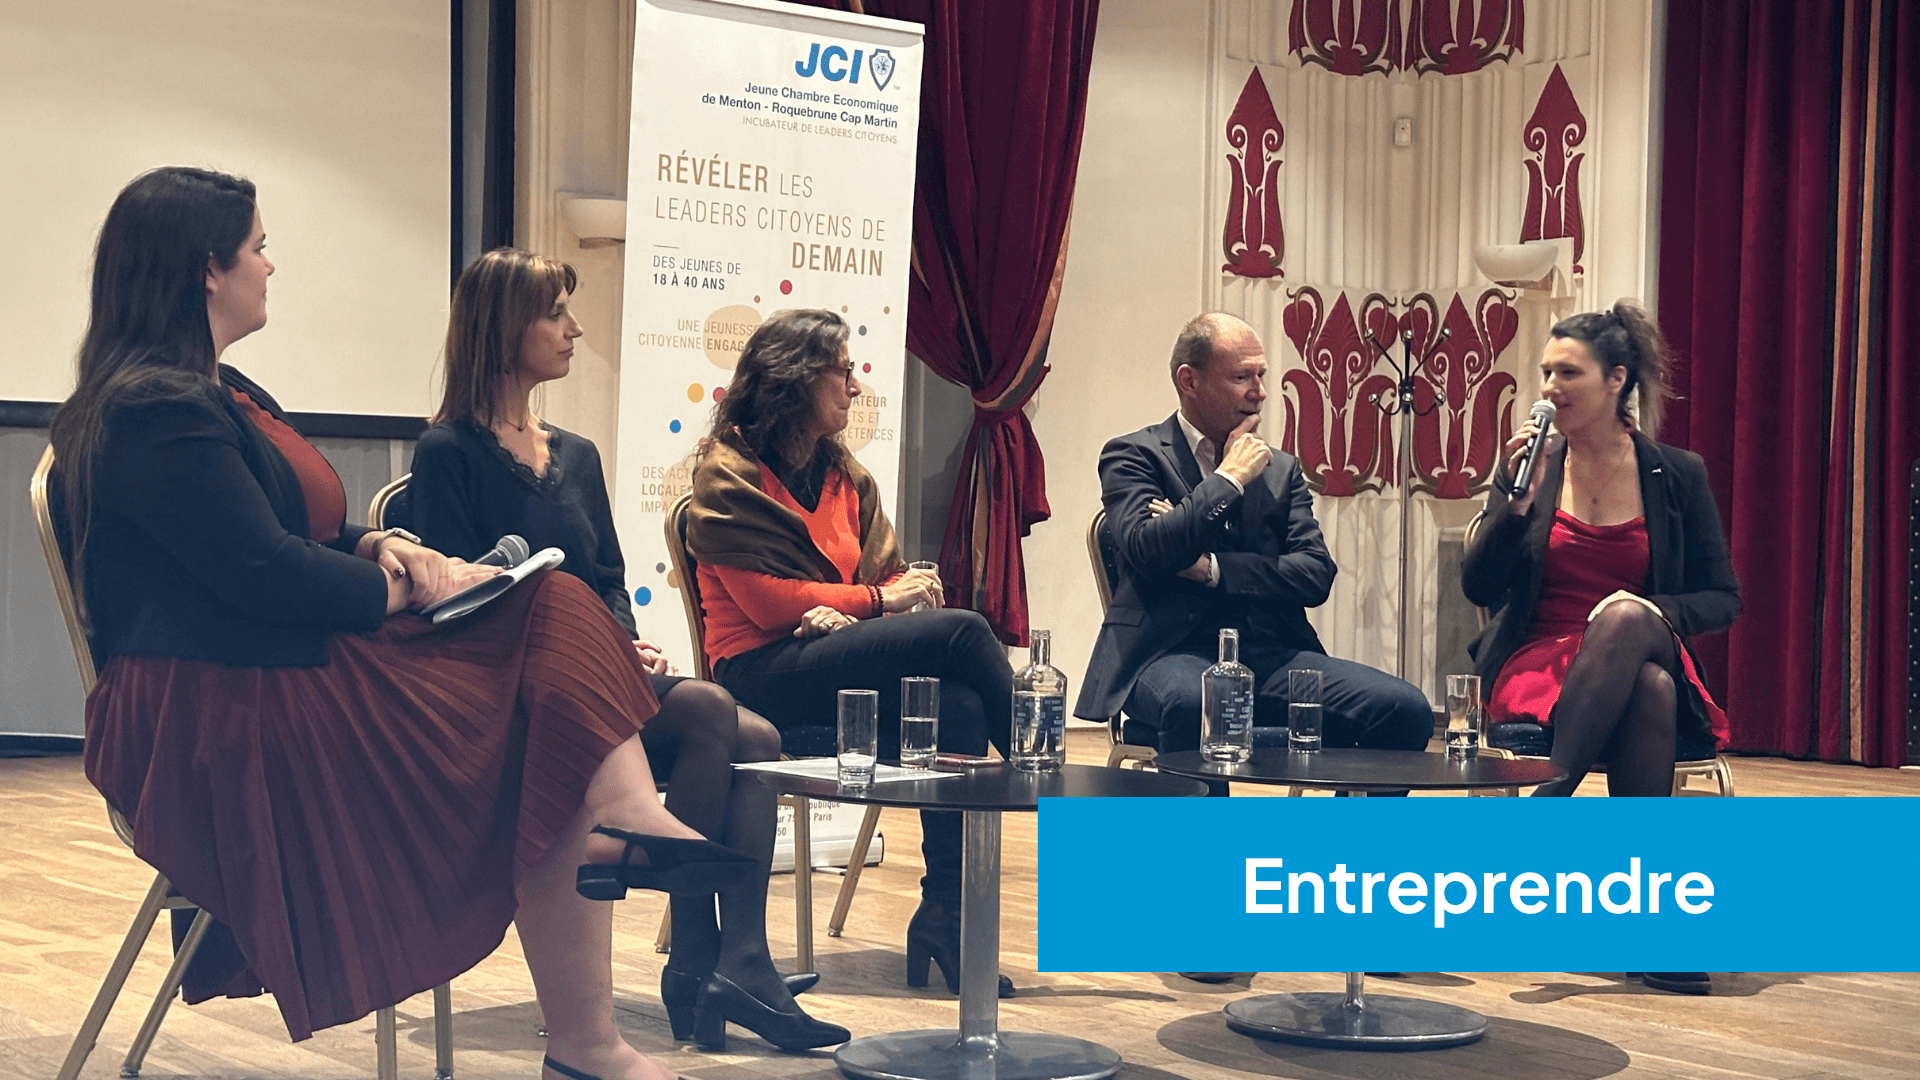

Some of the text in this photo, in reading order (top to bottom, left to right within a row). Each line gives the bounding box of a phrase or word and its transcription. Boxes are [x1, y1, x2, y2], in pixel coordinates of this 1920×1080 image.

[795, 43, 863, 84] JCI
[744, 82, 899, 113] Jeune Chambre Economique
[702, 93, 716, 105] de
[719, 96, 761, 111] Menton
[772, 102, 837, 121] Roquebrune
[840, 111, 861, 125] Cap
[864, 115, 898, 129] Martin
[742, 116, 898, 144] INCUBATEUR DE LEADERS CITOYENS
[657, 150, 813, 198] RÉVÉLER LES
[656, 196, 885, 242] LEADERS CITOYENS DE
[653, 255, 741, 275] DES JEUNES DE
[792, 242, 884, 277] DEMAIN
[653, 272, 725, 291] 18 À 40 ANS
[678, 319, 700, 332] UNE
[638, 333, 745, 352] CITOYENNE ENGAG
[852, 395, 887, 408] ATEUR
[852, 411, 880, 424] TS ET
[642, 466, 690, 480] DES ACT
[641, 501, 668, 513] IMPA
[814, 812, 832, 822] Paris
